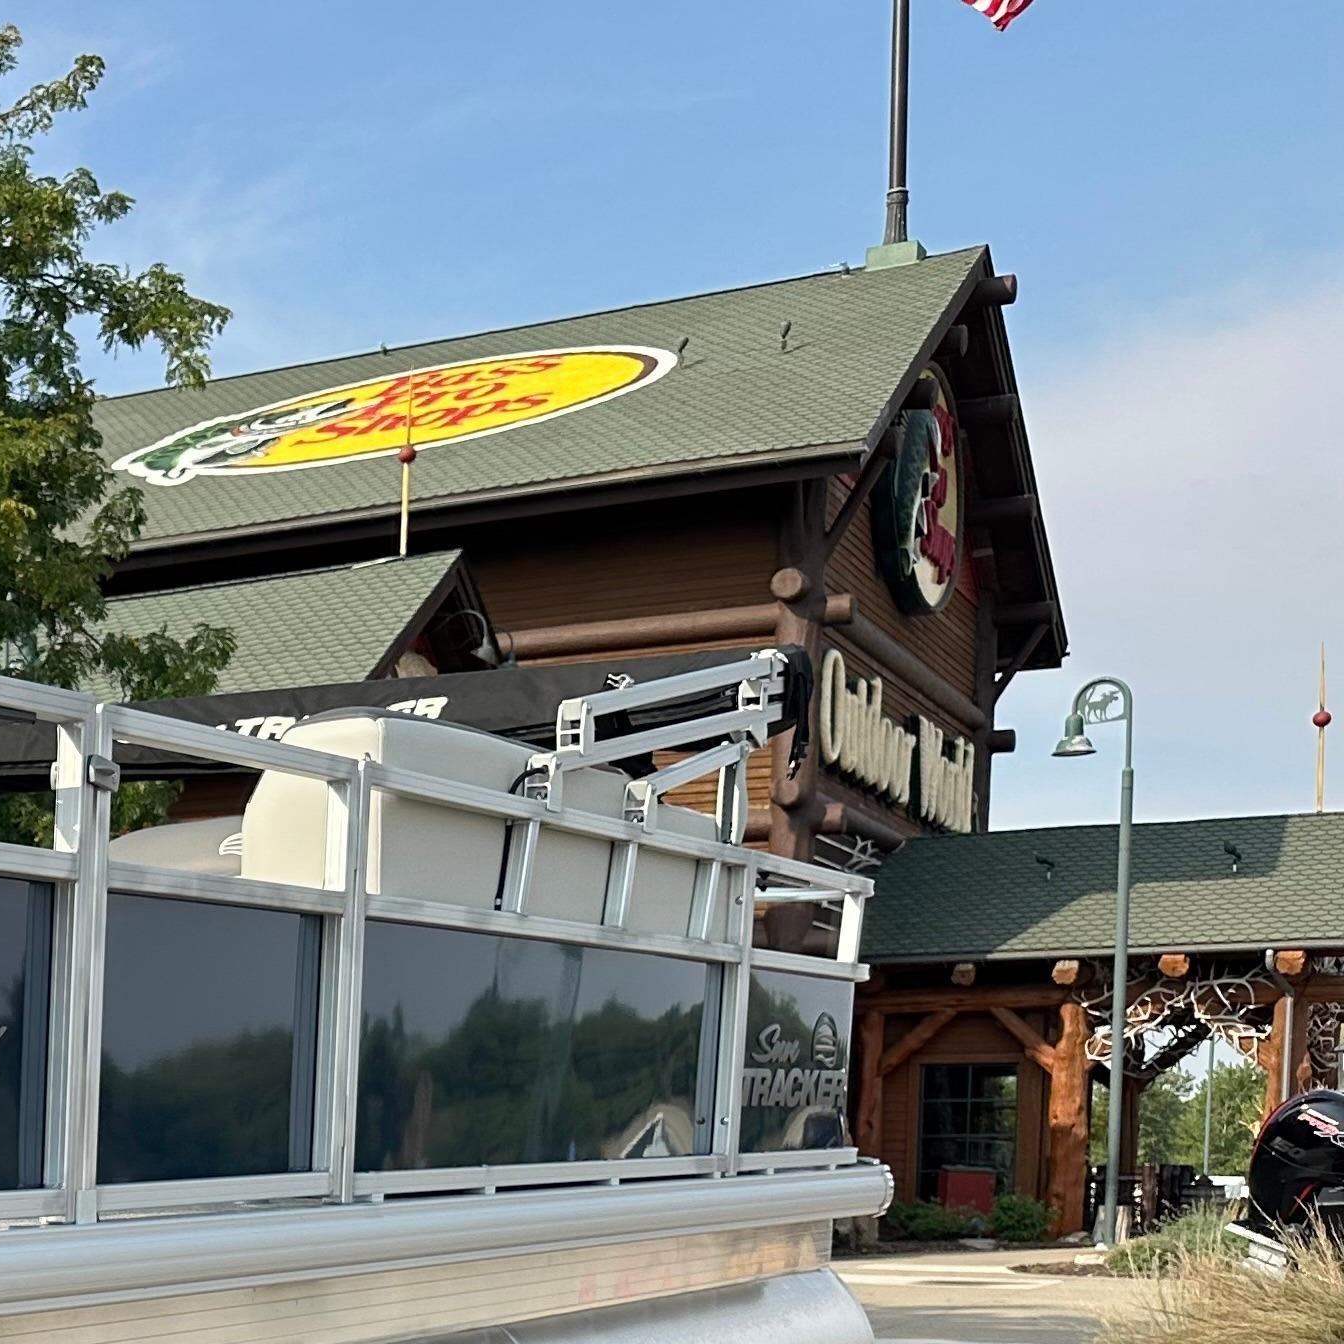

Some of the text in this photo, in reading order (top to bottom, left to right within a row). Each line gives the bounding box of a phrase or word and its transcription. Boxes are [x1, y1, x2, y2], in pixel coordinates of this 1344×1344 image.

[374, 355, 568, 400] Bass
[289, 392, 555, 447] Shops
[349, 381, 508, 423] Pro
[750, 1023, 801, 1063] Sun
[741, 1067, 847, 1108] TRACKER
